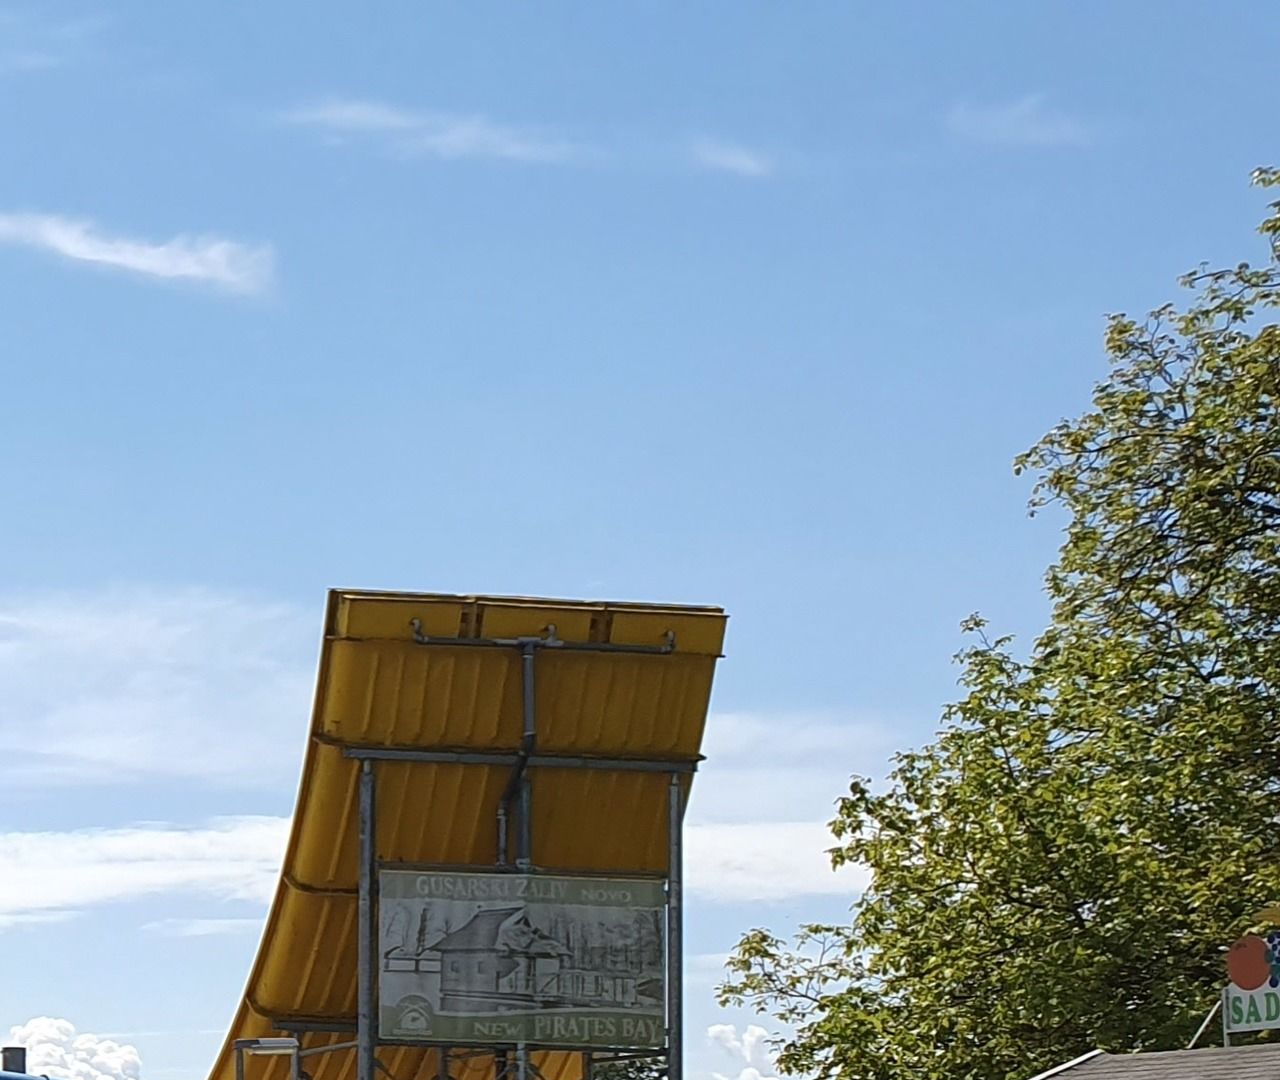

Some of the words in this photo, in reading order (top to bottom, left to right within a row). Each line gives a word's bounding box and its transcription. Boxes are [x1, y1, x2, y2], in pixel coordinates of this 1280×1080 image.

[416, 876, 508, 898] GUSARSKI
[516, 878, 569, 899] ZALIV
[581, 887, 632, 902] NOVO
[473, 1021, 523, 1037] NEW
[622, 1018, 660, 1044] BAY
